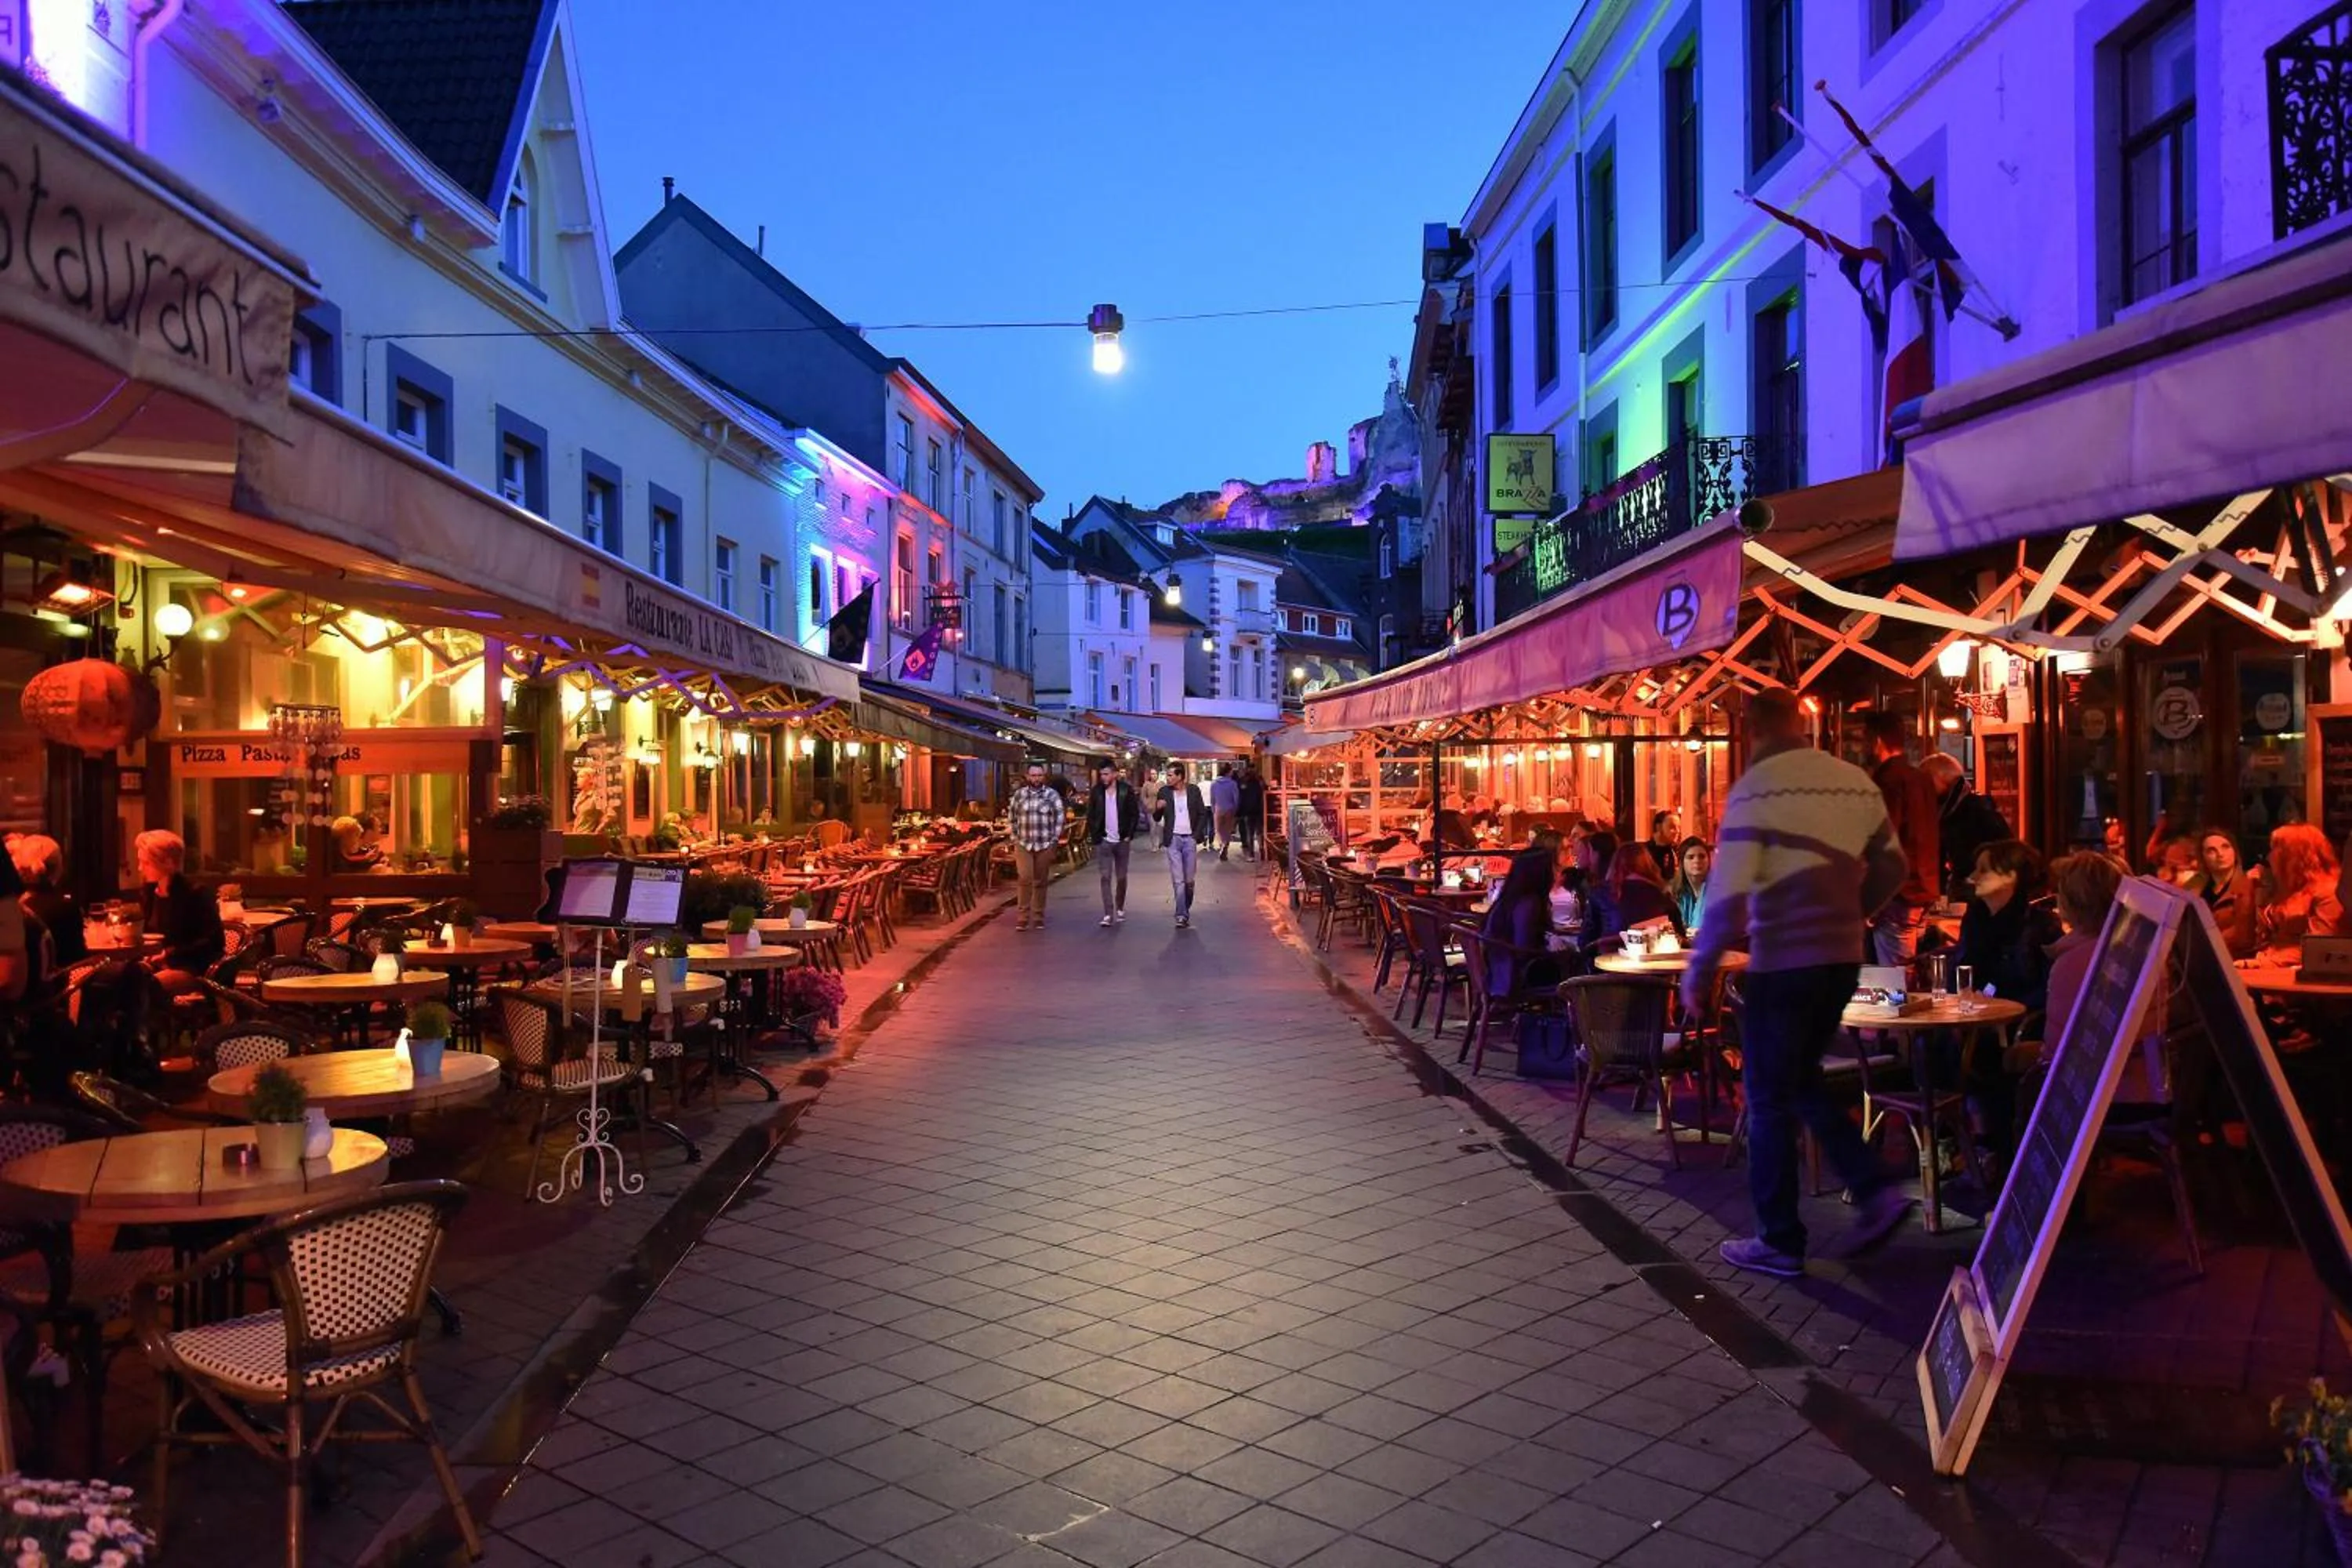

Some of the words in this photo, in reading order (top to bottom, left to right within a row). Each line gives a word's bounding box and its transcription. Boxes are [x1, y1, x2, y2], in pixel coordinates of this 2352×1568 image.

[1663, 583, 1694, 636] B
[181, 746, 226, 763] Pizza
[241, 745, 292, 764] Pas
